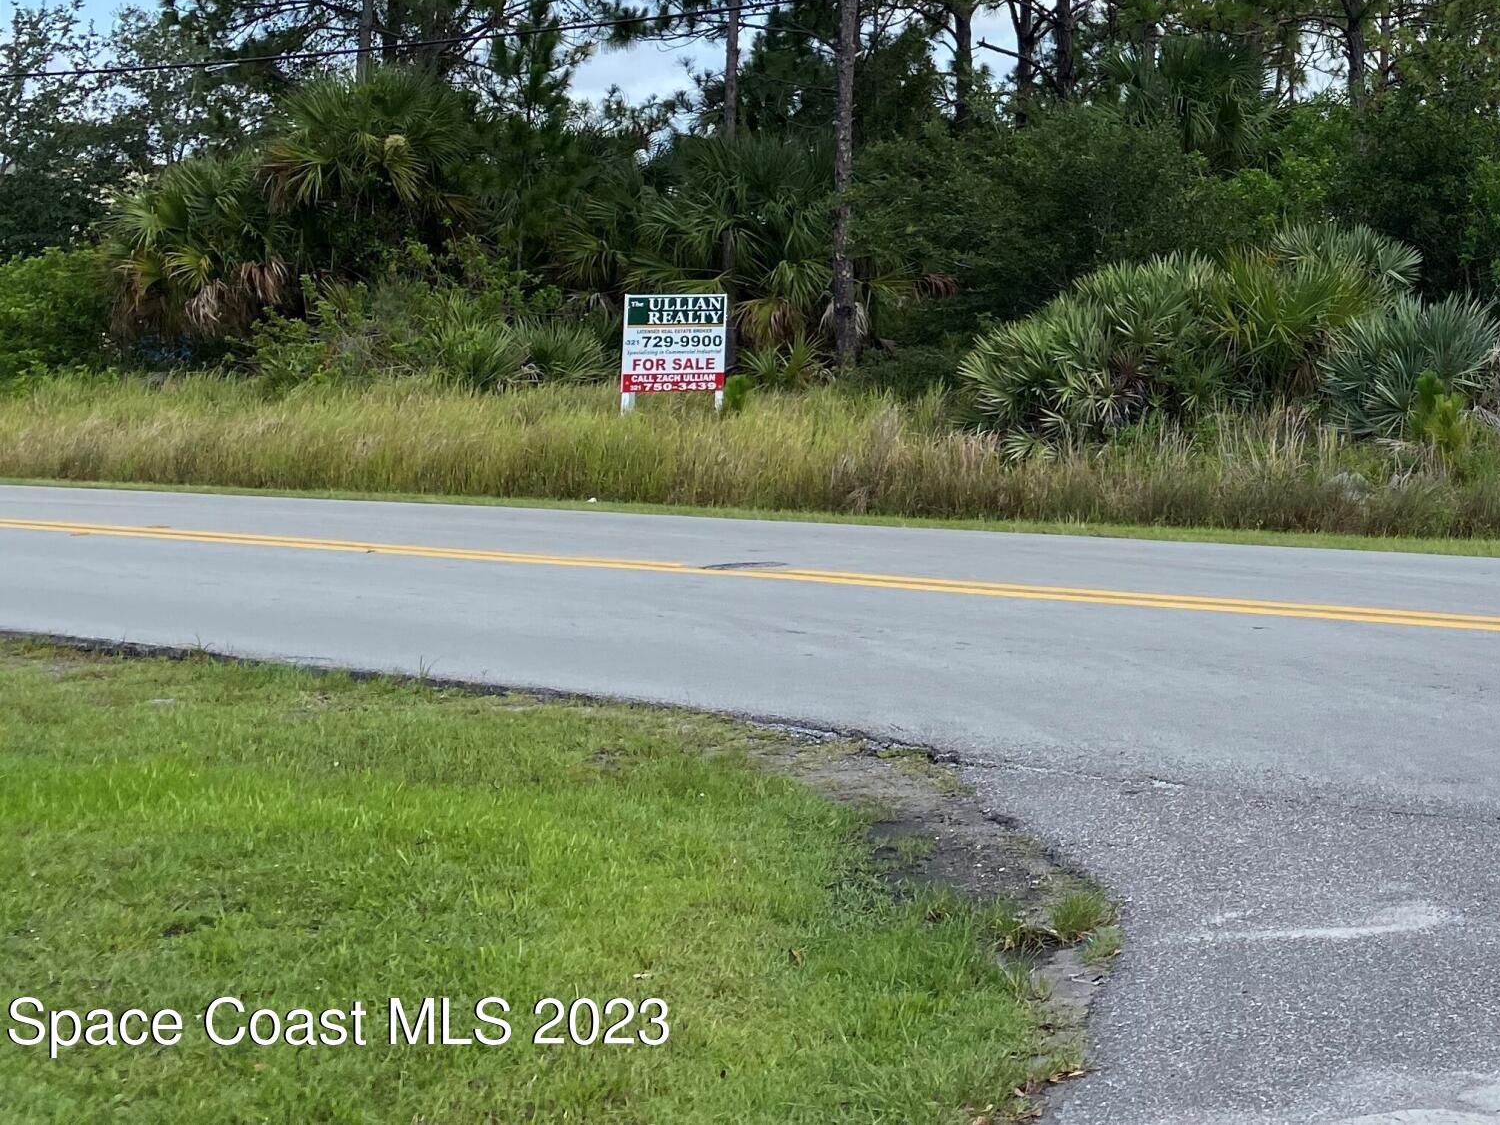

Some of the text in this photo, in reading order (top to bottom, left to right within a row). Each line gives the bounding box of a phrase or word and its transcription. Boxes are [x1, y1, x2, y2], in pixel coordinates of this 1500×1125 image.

[648, 297, 722, 311] ULLIAN
[647, 311, 722, 324] REALTY
[642, 335, 722, 348] 729-9900
[632, 358, 715, 371] FOR SALE
[631, 374, 716, 383] CALL ZACH ULLIAN
[643, 382, 717, 391] 750-3439
